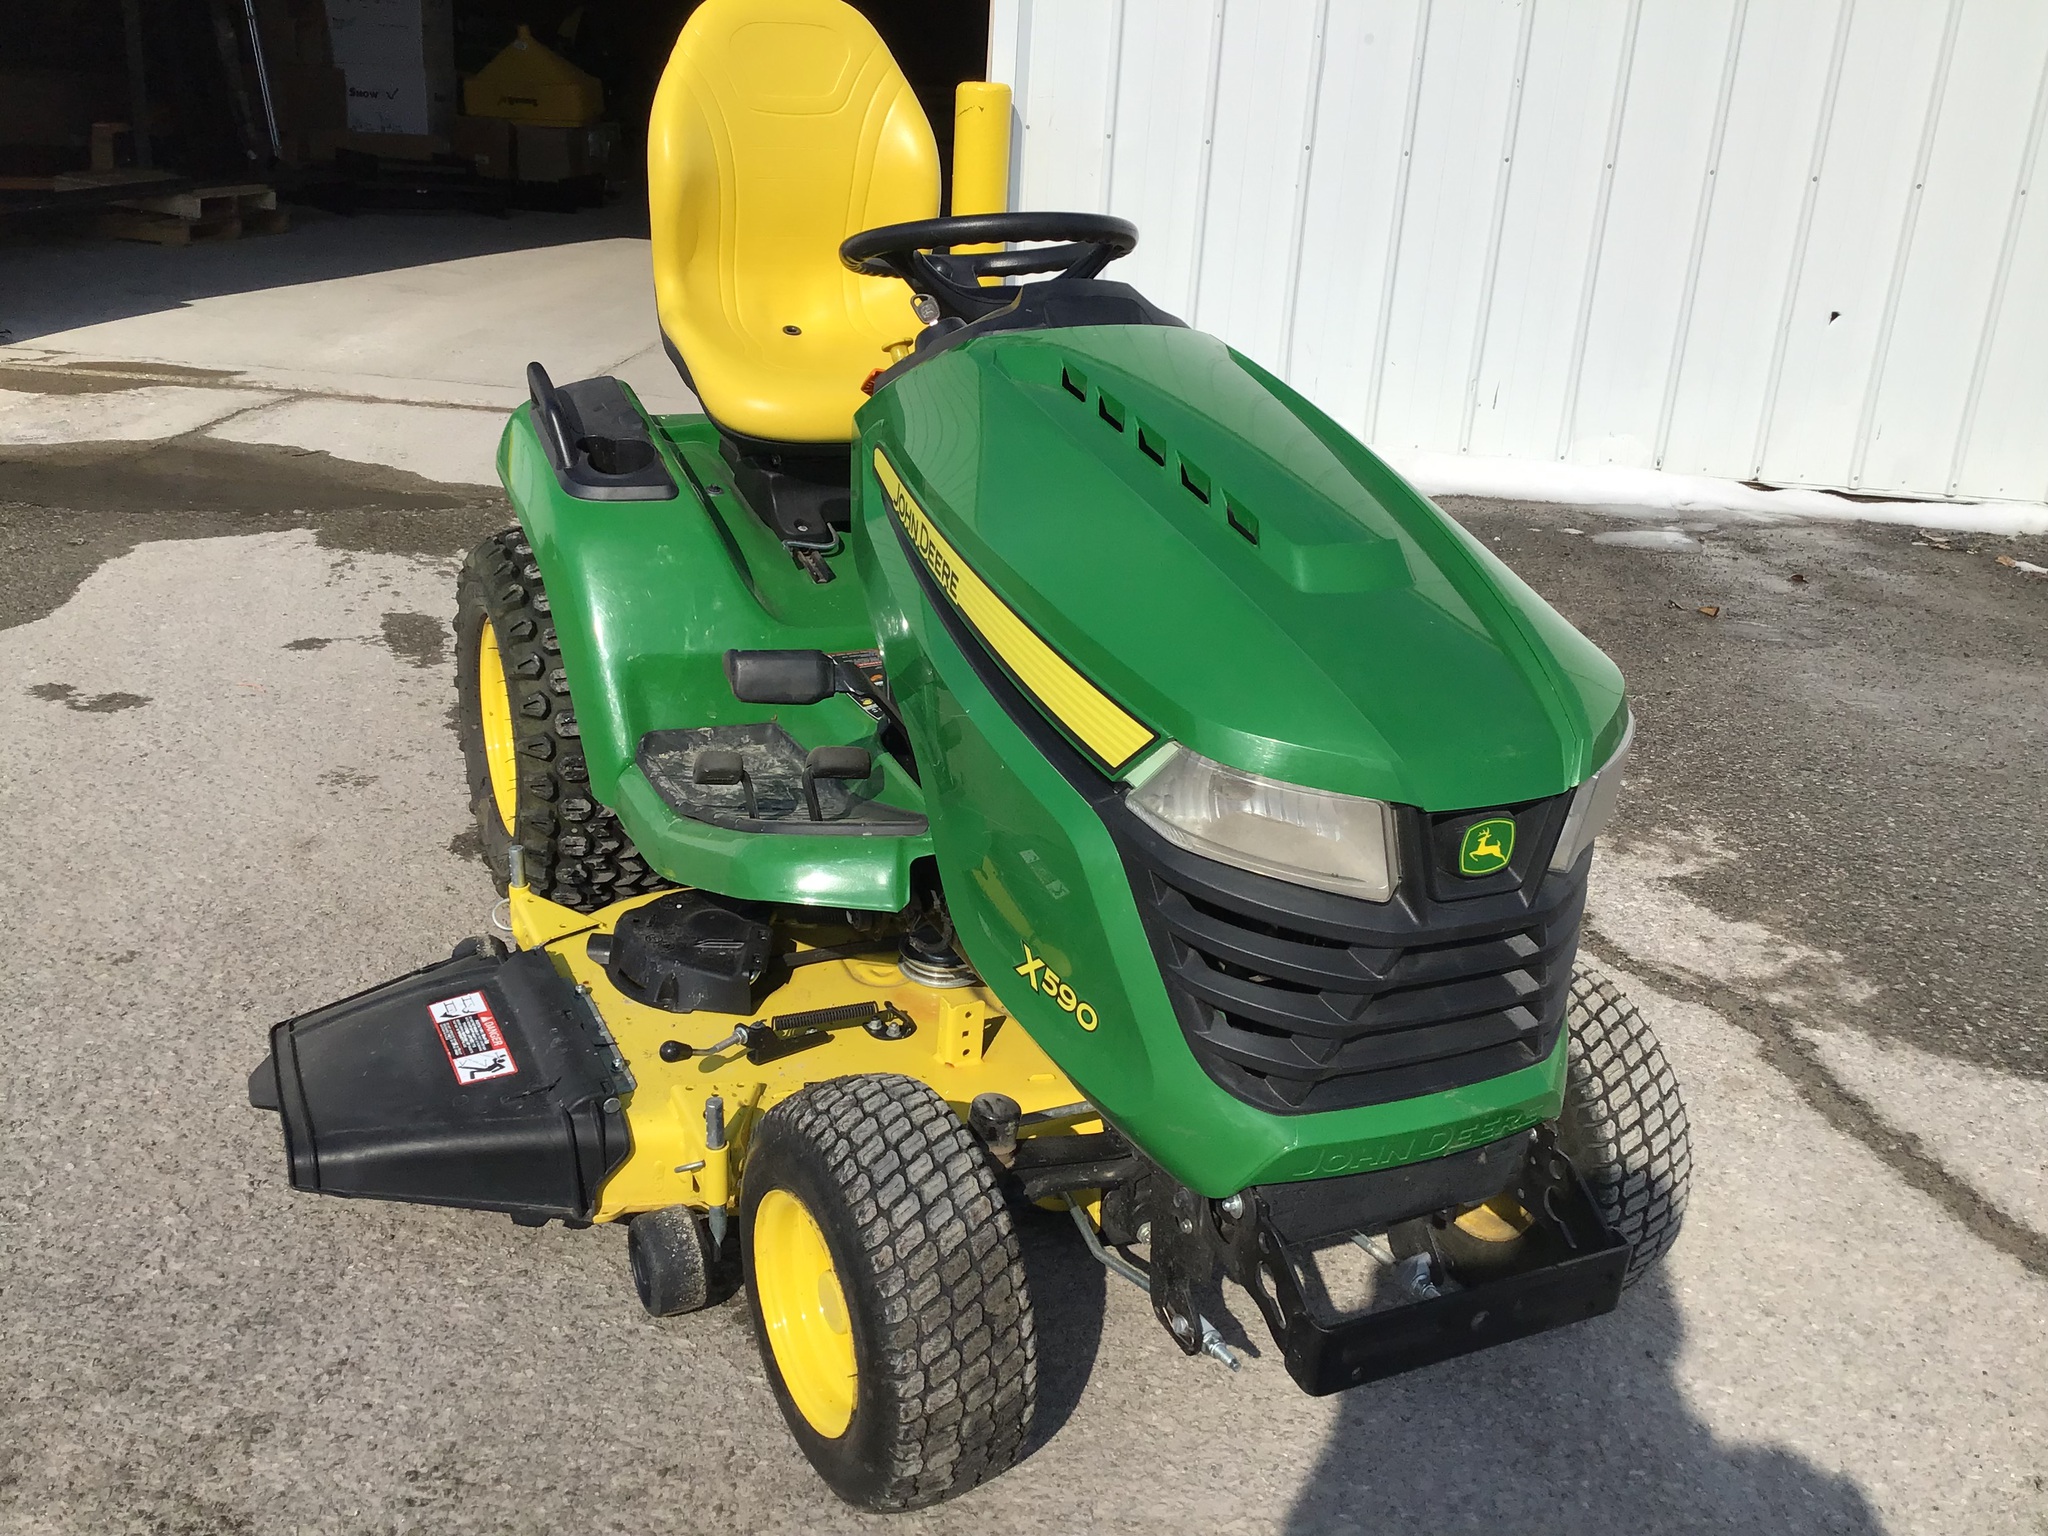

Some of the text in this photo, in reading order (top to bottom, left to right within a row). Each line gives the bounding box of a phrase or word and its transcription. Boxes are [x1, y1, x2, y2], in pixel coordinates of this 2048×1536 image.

[893, 483, 960, 600] JOHN DEERE
[1013, 939, 1100, 1033] X590
[484, 1021, 504, 1047] DANGER
[1293, 1105, 1544, 1177] JOHN DEERE
